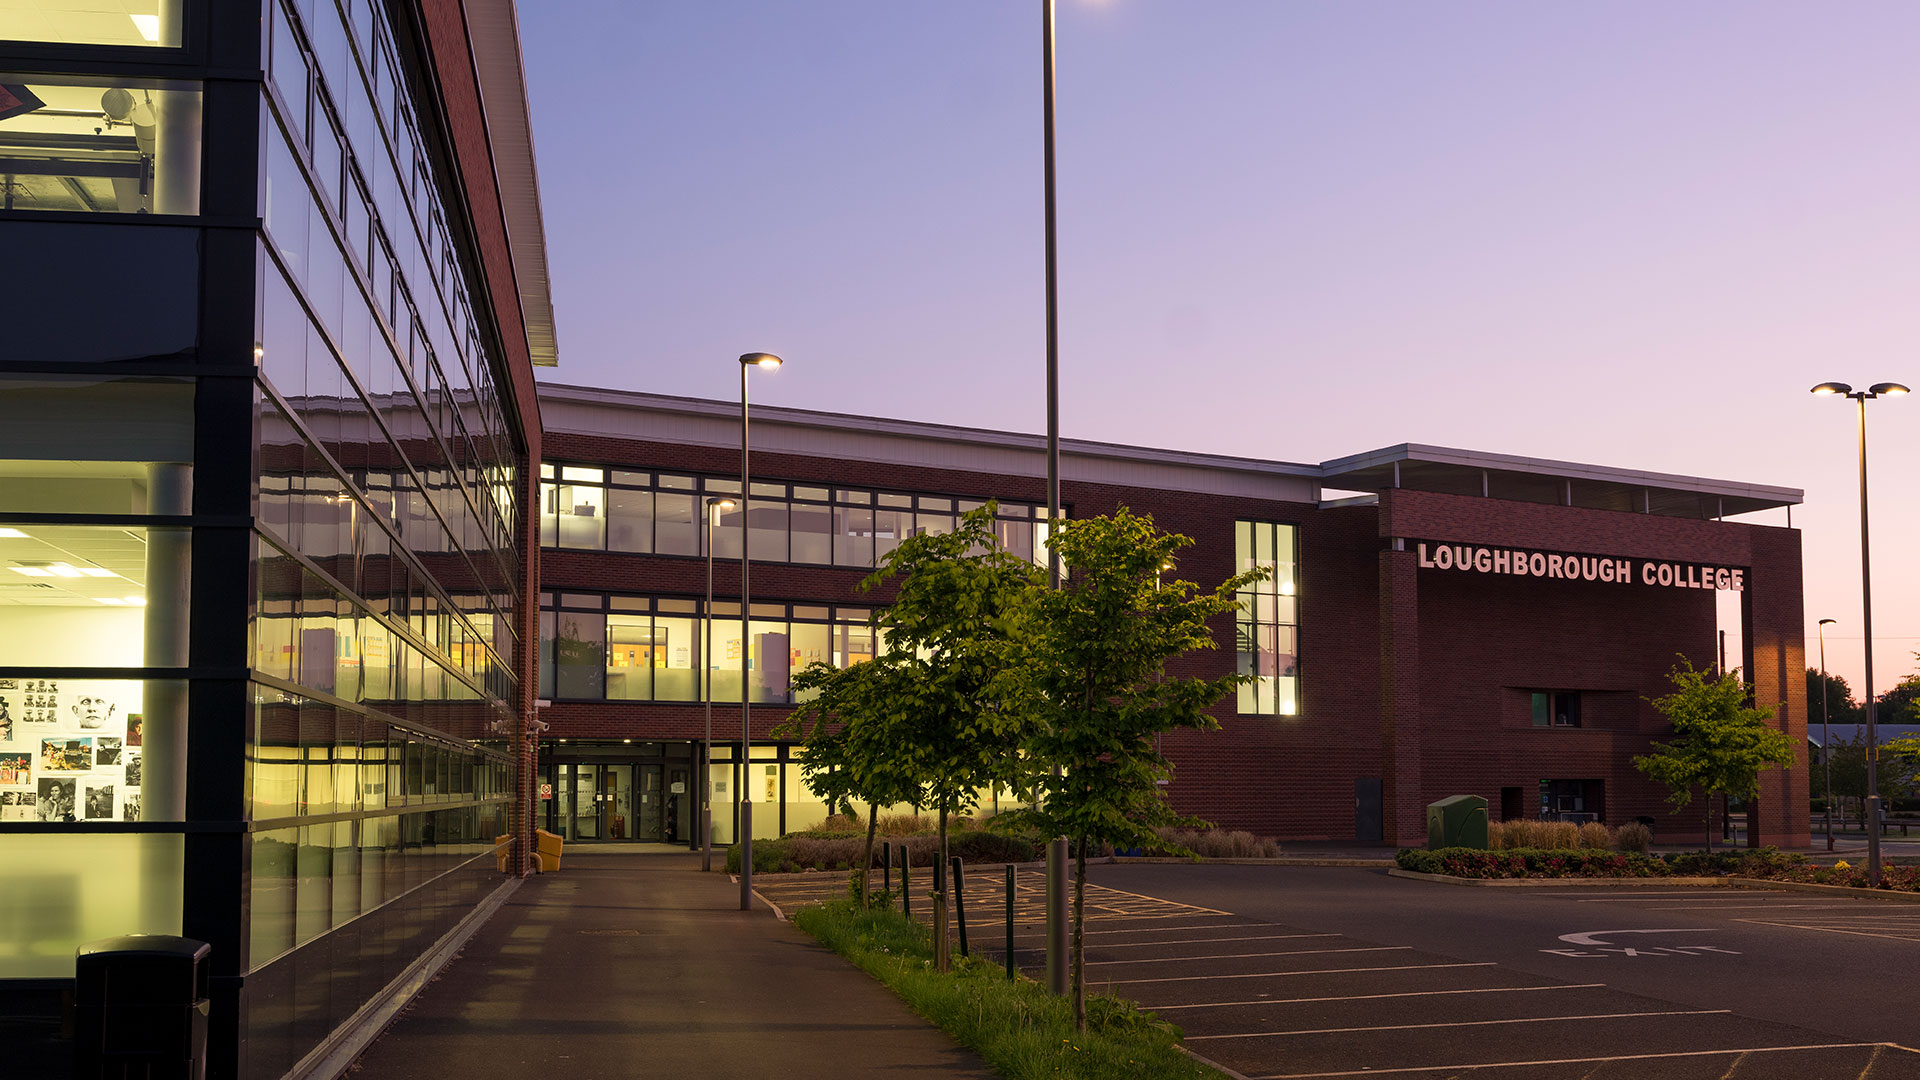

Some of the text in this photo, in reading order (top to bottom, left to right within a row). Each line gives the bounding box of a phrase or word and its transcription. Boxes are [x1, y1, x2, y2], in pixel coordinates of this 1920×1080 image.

[1418, 543, 1744, 591] LOUGHBOROUGH COLLEGE
[1538, 946, 1743, 958] EXIT
